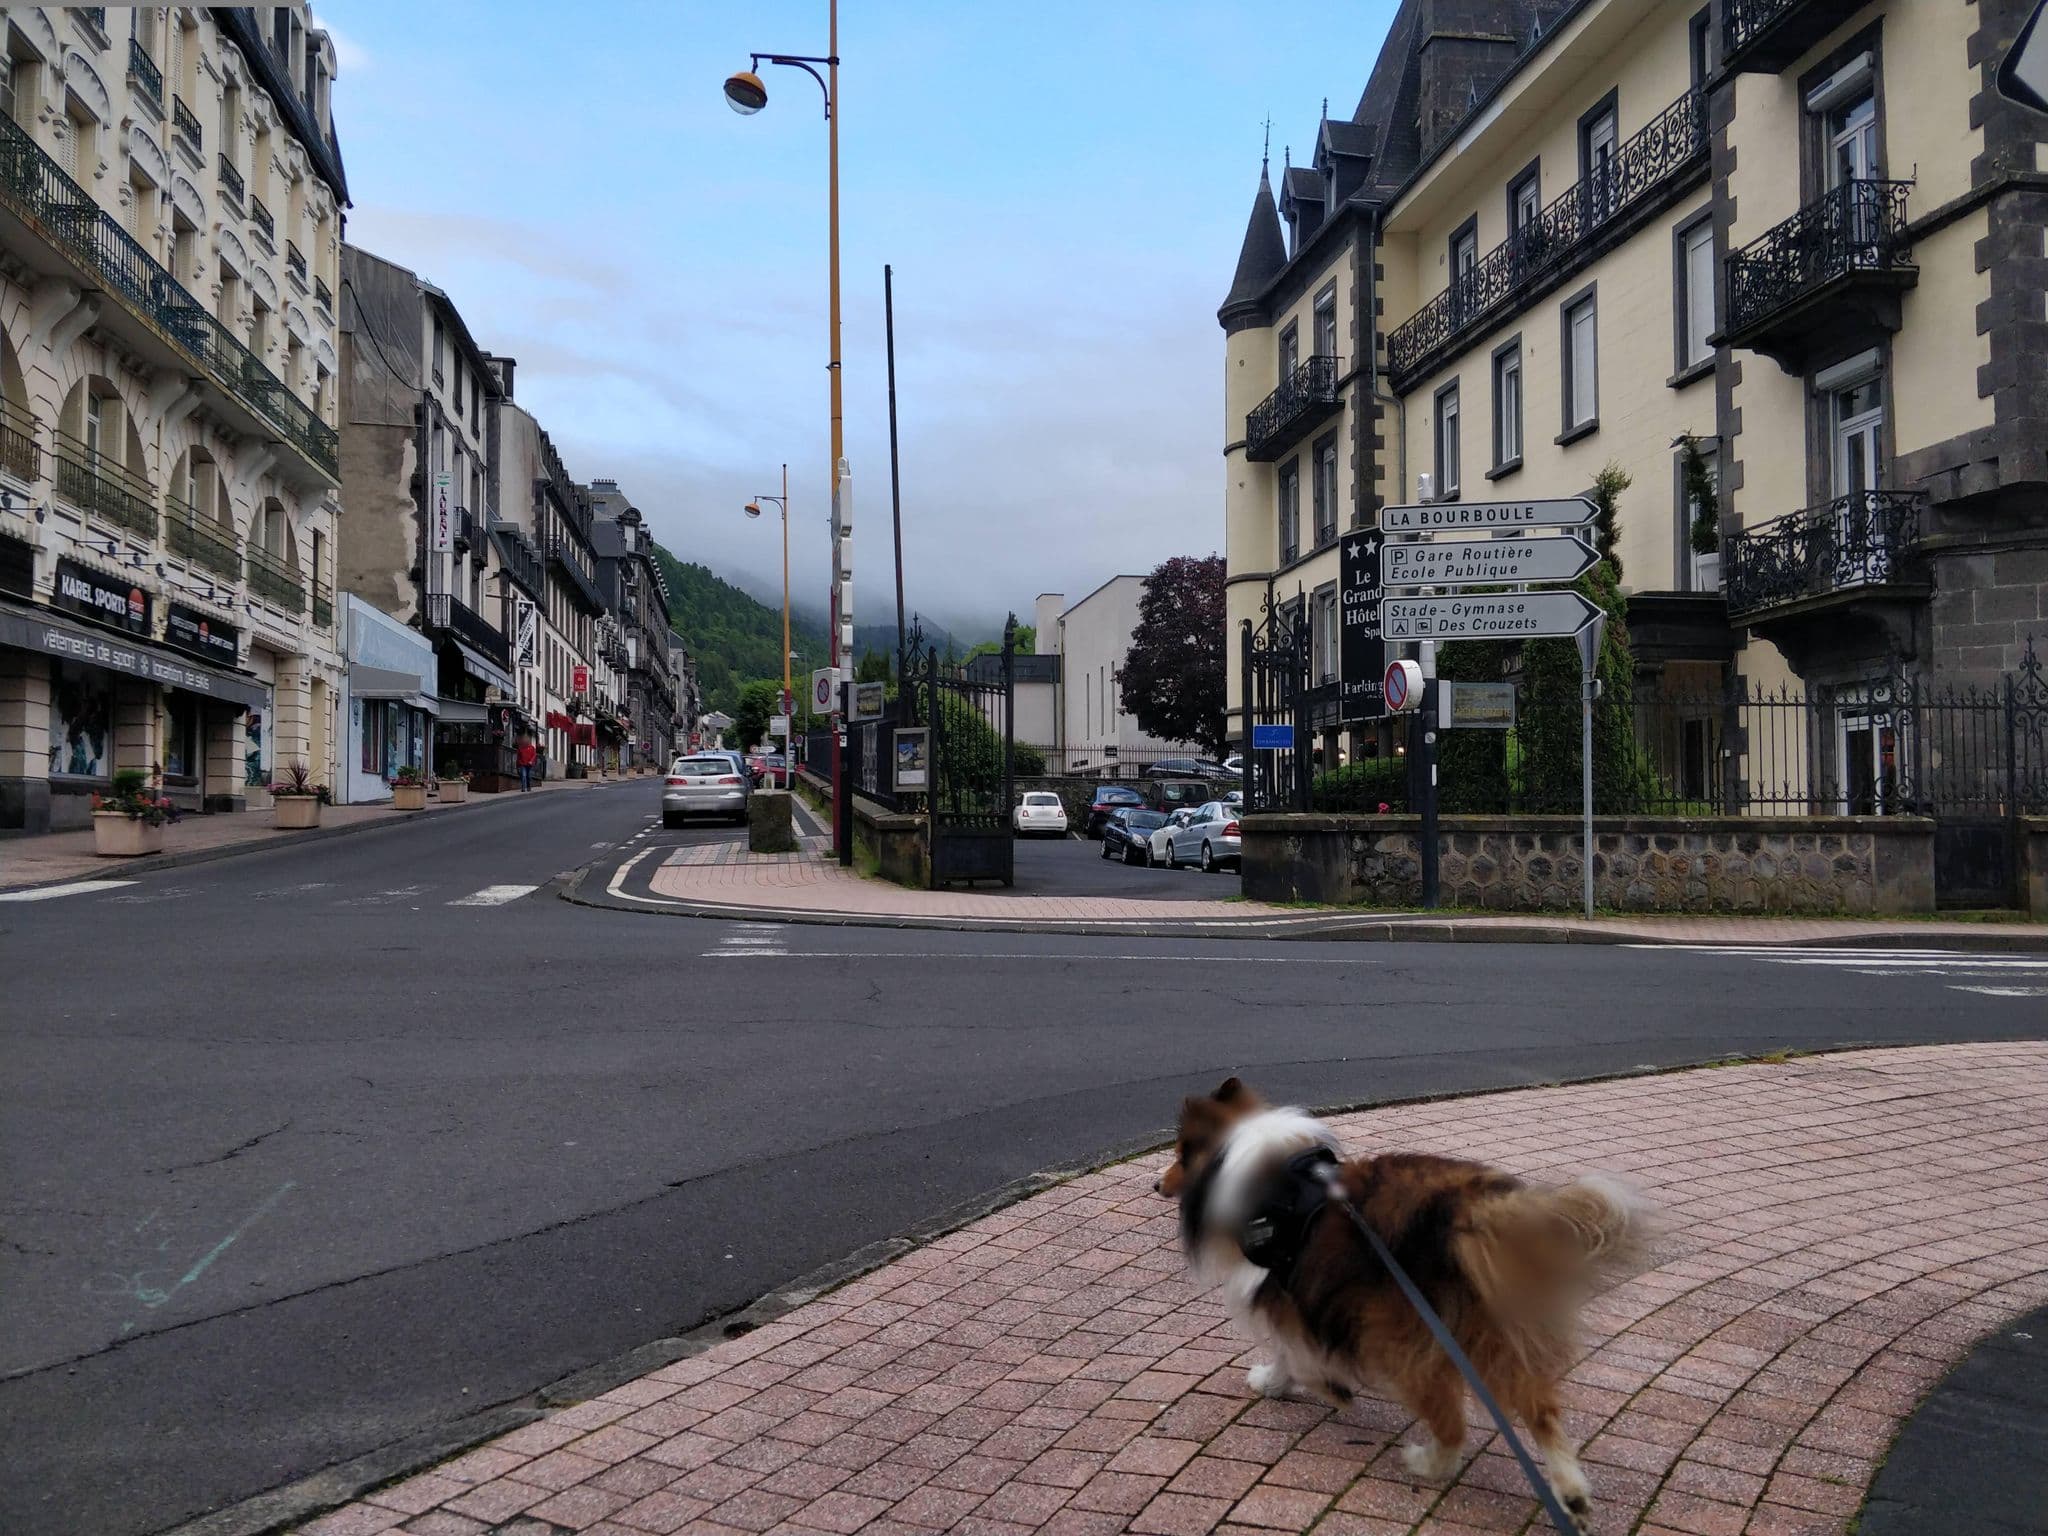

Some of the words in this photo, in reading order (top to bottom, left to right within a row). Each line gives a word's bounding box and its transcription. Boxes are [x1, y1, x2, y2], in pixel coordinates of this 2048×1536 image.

[1390, 513, 1410, 526] LA
[1420, 507, 1535, 524] BOURBOULE
[1415, 550, 1453, 562] Gare
[1462, 547, 1533, 561] Routière
[1355, 570, 1371, 586] Le
[1391, 566, 1436, 579] Ecole
[1444, 563, 1519, 579] Publique
[61, 574, 94, 606] KAREL
[95, 588, 126, 616] SPORTS
[1343, 582, 1383, 605] Grand
[1346, 604, 1381, 626] Hôtel
[1439, 619, 1466, 632] Des
[1472, 617, 1538, 631] Crouzets
[1364, 626, 1381, 640] Spa
[42, 629, 95, 657] vêtements
[97, 644, 110, 662] de
[113, 648, 136, 671] sport
[152, 660, 184, 687] location
